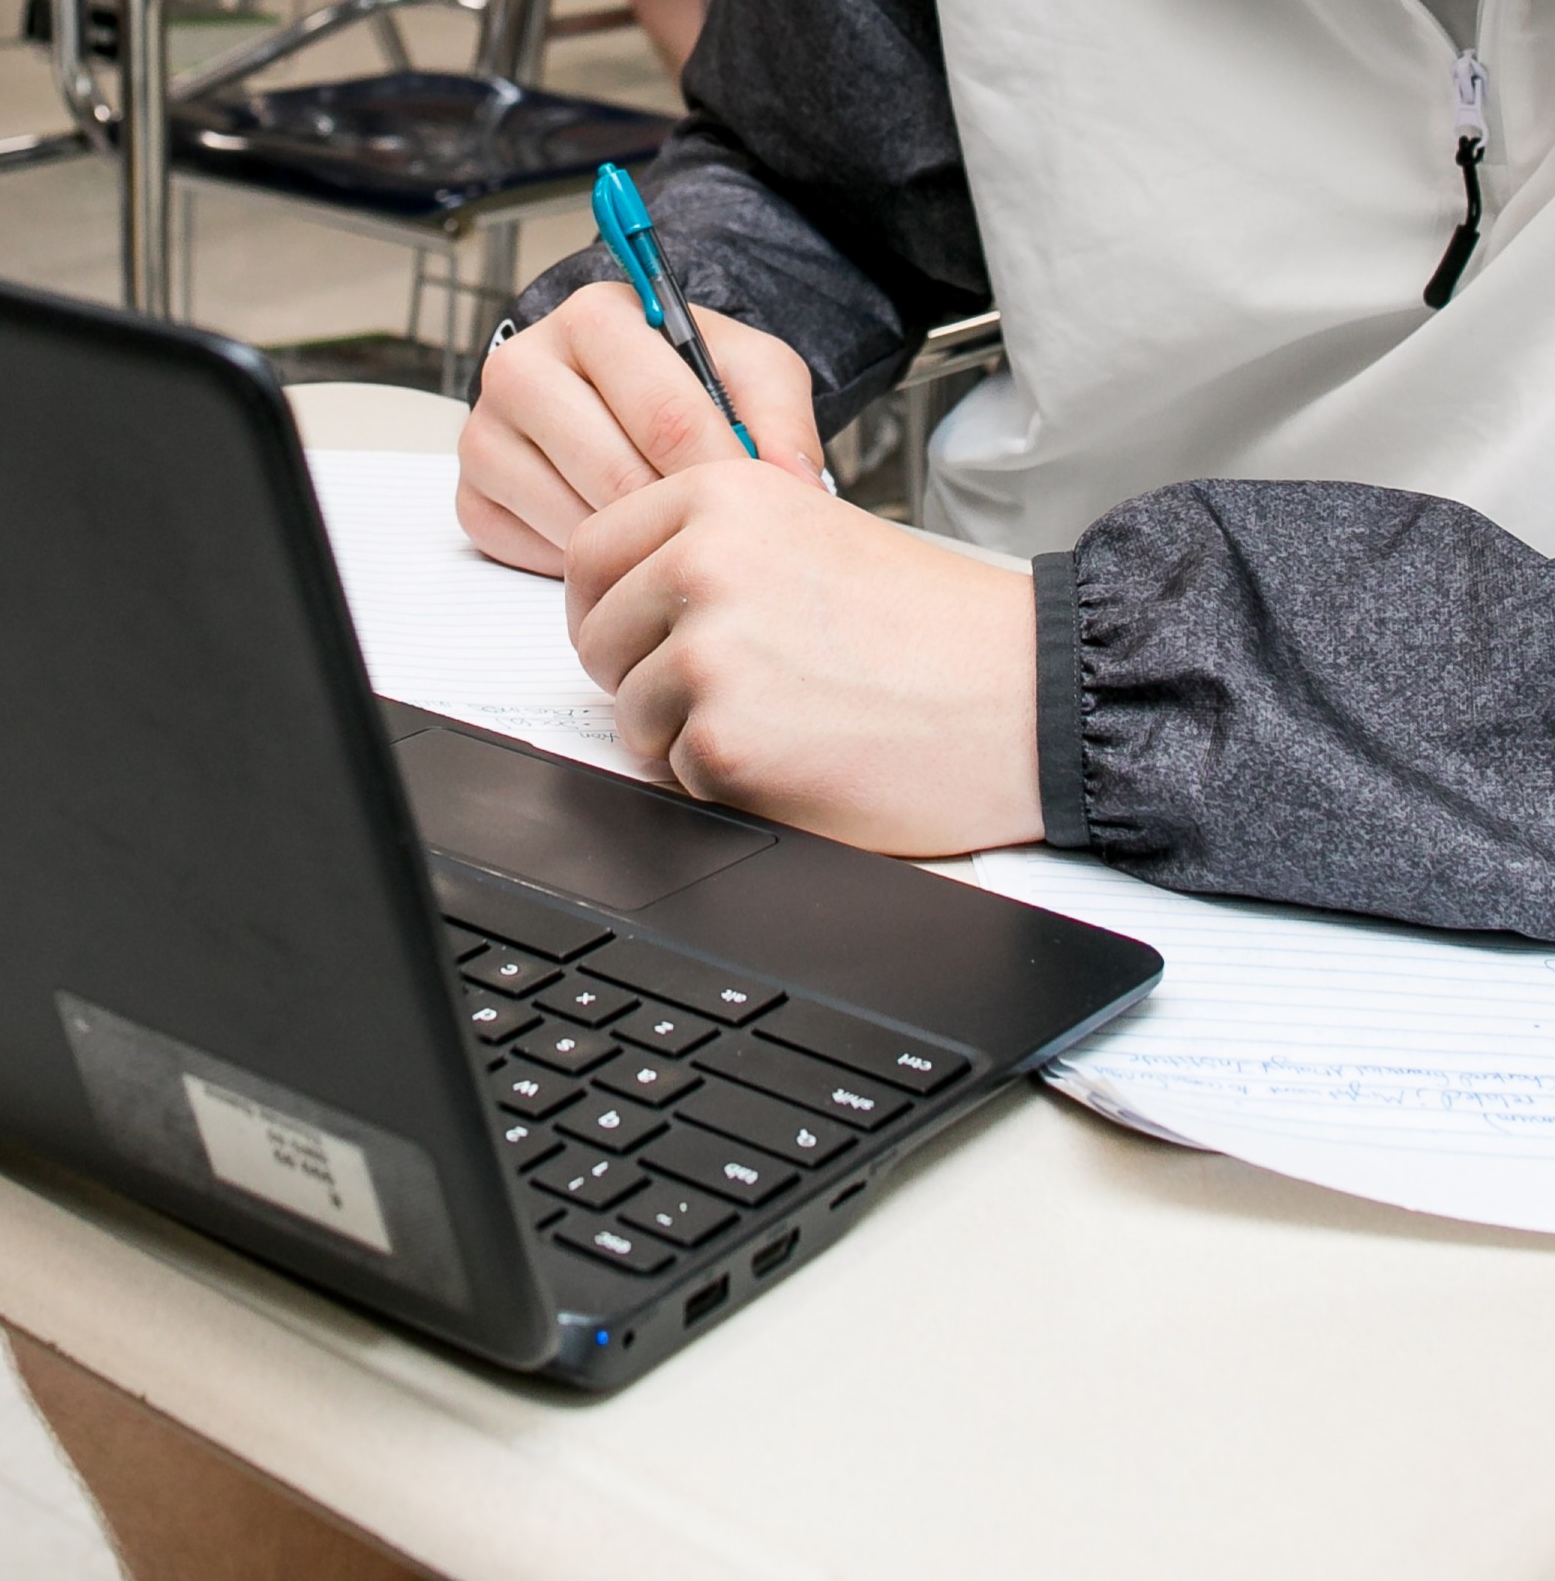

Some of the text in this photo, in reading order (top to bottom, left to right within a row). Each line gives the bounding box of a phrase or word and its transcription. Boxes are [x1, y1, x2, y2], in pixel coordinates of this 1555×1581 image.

[721, 989, 747, 1003] alt
[898, 1053, 932, 1071] ctrl
[832, 1088, 875, 1110] shift
[724, 1163, 758, 1185] tab
[595, 1231, 632, 1254] esc
